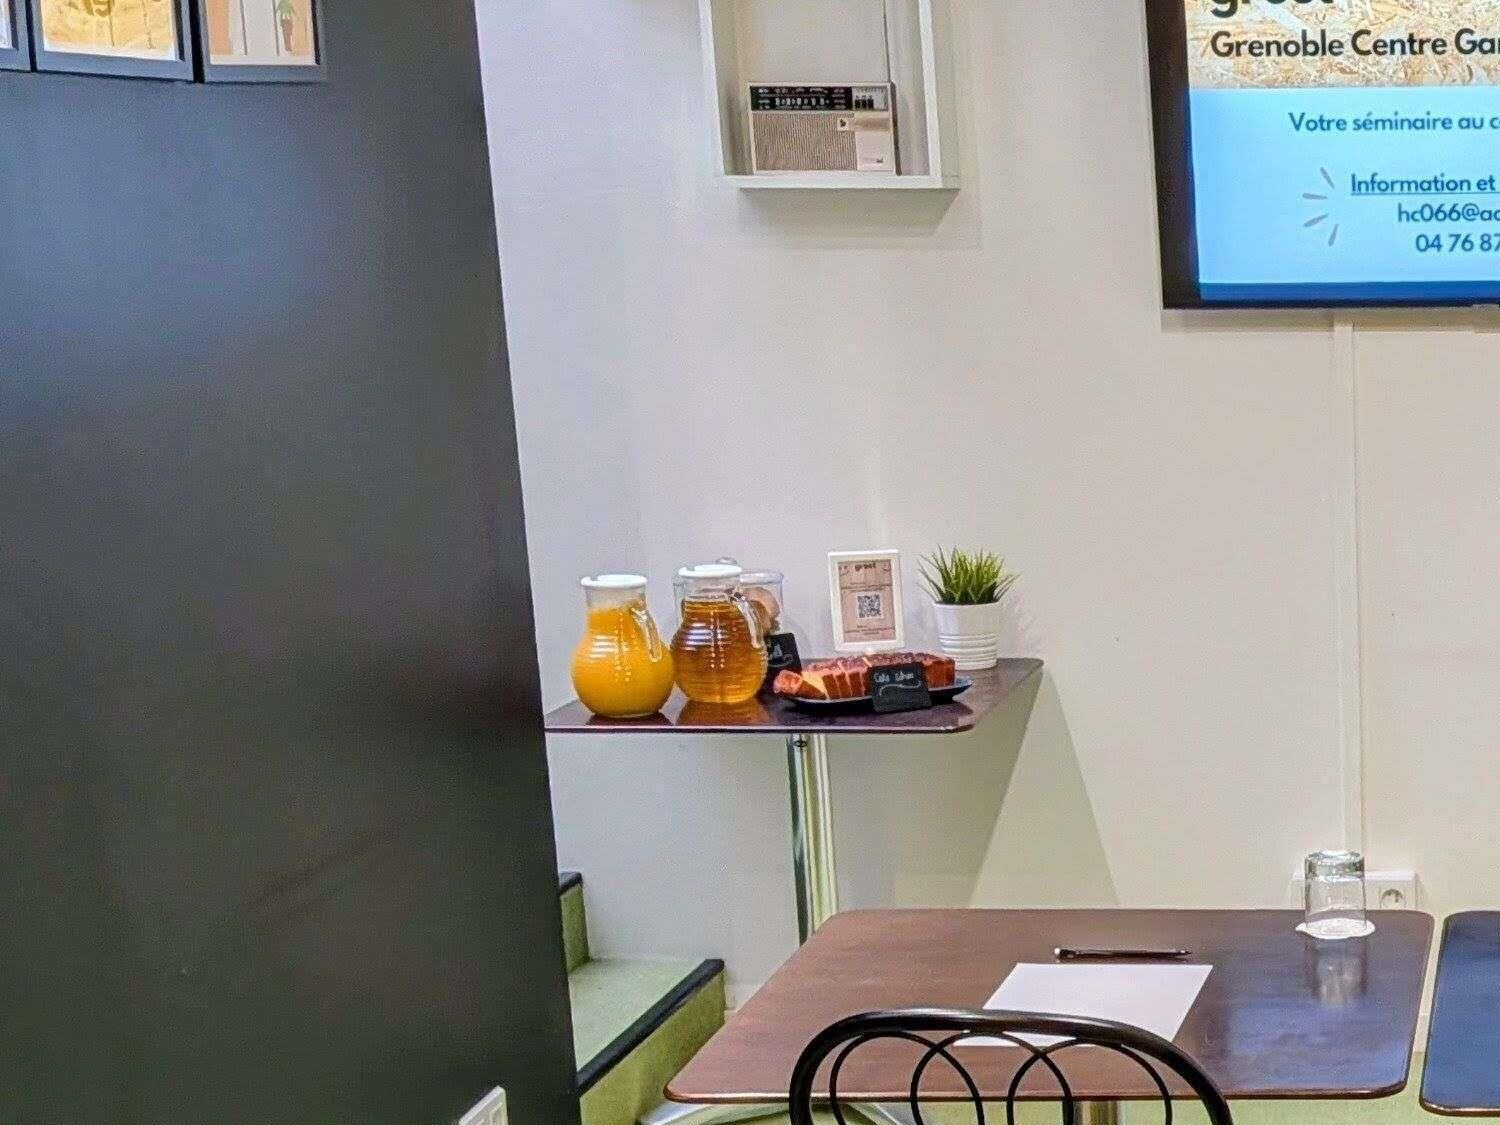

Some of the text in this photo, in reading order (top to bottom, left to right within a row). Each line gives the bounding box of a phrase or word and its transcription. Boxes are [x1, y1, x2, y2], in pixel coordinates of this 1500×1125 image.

[1210, 29, 1345, 58] Grenoble
[1351, 29, 1447, 56] Centre
[1289, 112, 1347, 132] Votre
[1353, 111, 1453, 131] séminaire
[1458, 117, 1484, 130] au
[1351, 172, 1472, 193] Information
[1476, 175, 1496, 192] et
[1415, 234, 1442, 253] 04
[1449, 233, 1474, 252] 76
